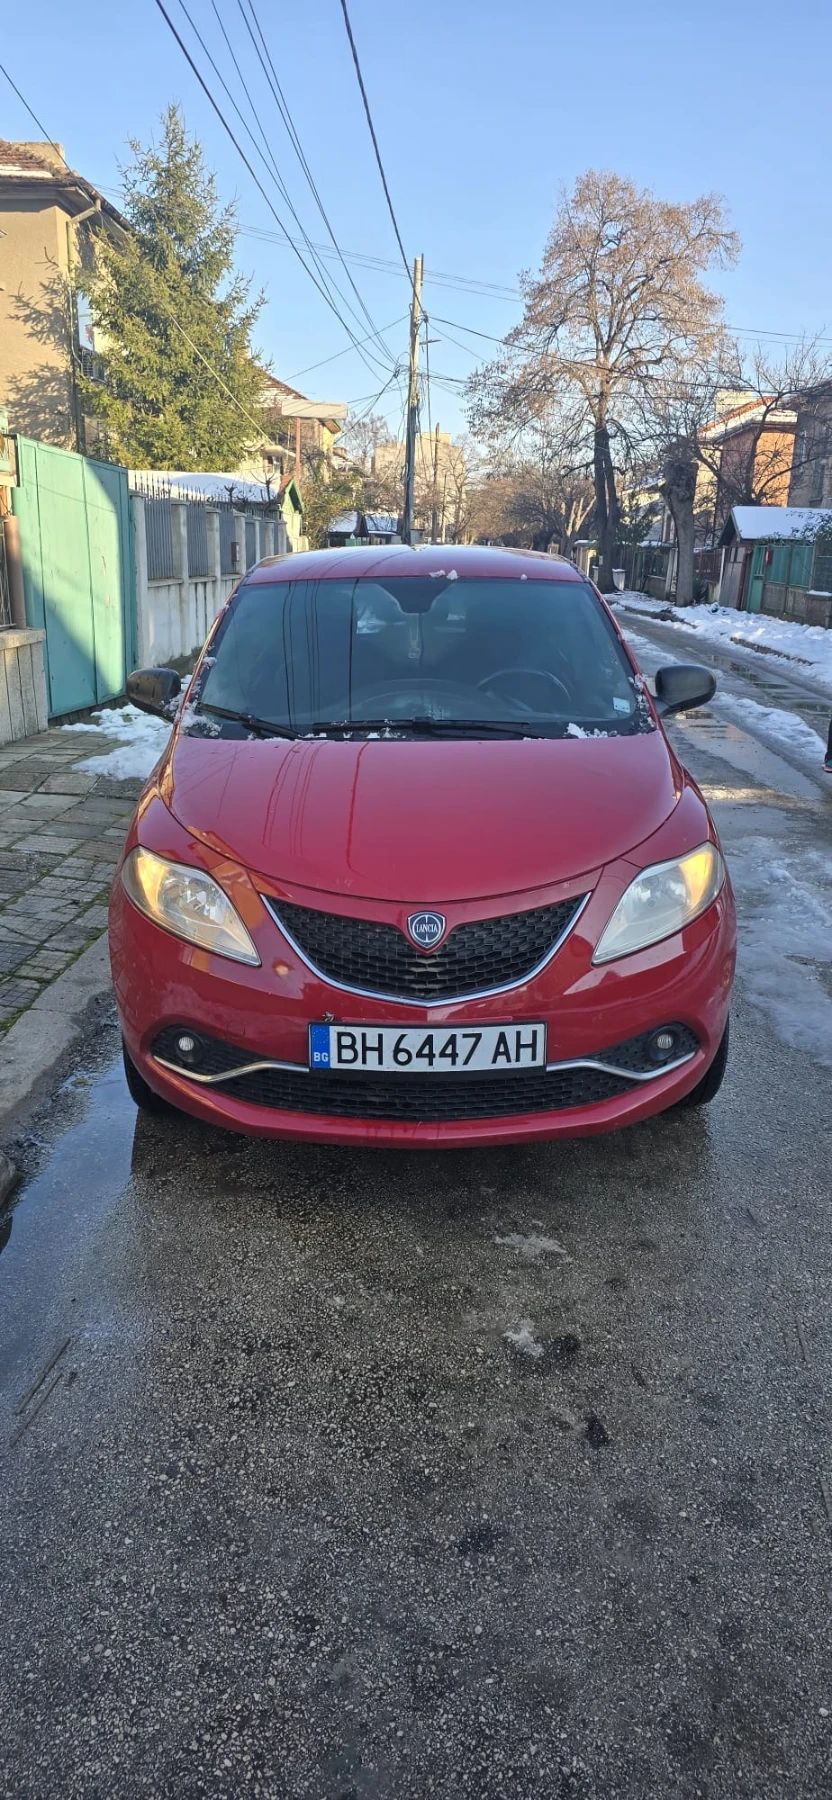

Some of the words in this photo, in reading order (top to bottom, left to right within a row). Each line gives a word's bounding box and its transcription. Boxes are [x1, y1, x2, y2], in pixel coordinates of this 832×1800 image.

[416, 924, 438, 932] LANCIA
[337, 1031, 383, 1065] BH
[393, 1033, 483, 1066] 6447
[491, 1029, 538, 1064] AH
[313, 1052, 329, 1062] BG
